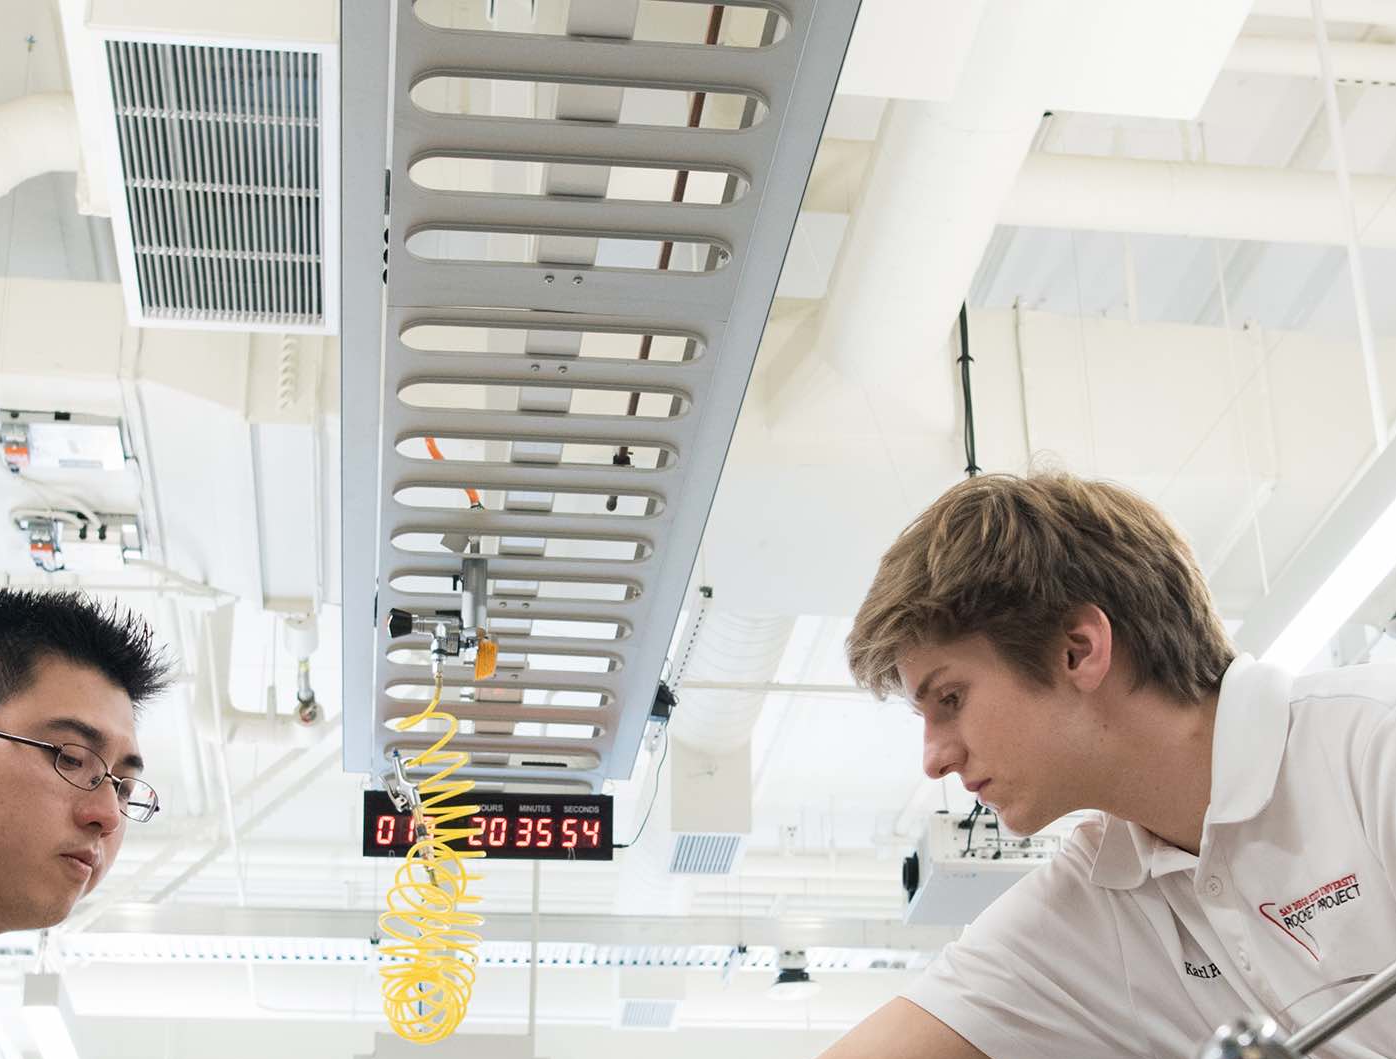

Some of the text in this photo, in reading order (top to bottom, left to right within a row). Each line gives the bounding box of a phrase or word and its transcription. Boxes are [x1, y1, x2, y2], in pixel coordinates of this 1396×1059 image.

[519, 804, 551, 813] MINUTES
[563, 805, 600, 815] SECONDS
[468, 817, 507, 847] 20
[515, 817, 552, 848] 35
[561, 818, 601, 848] 54
[1319, 873, 1358, 896] UNIVERSITY
[1283, 883, 1361, 930] ROCKET PROJECT
[1184, 961, 1211, 979] Karl
